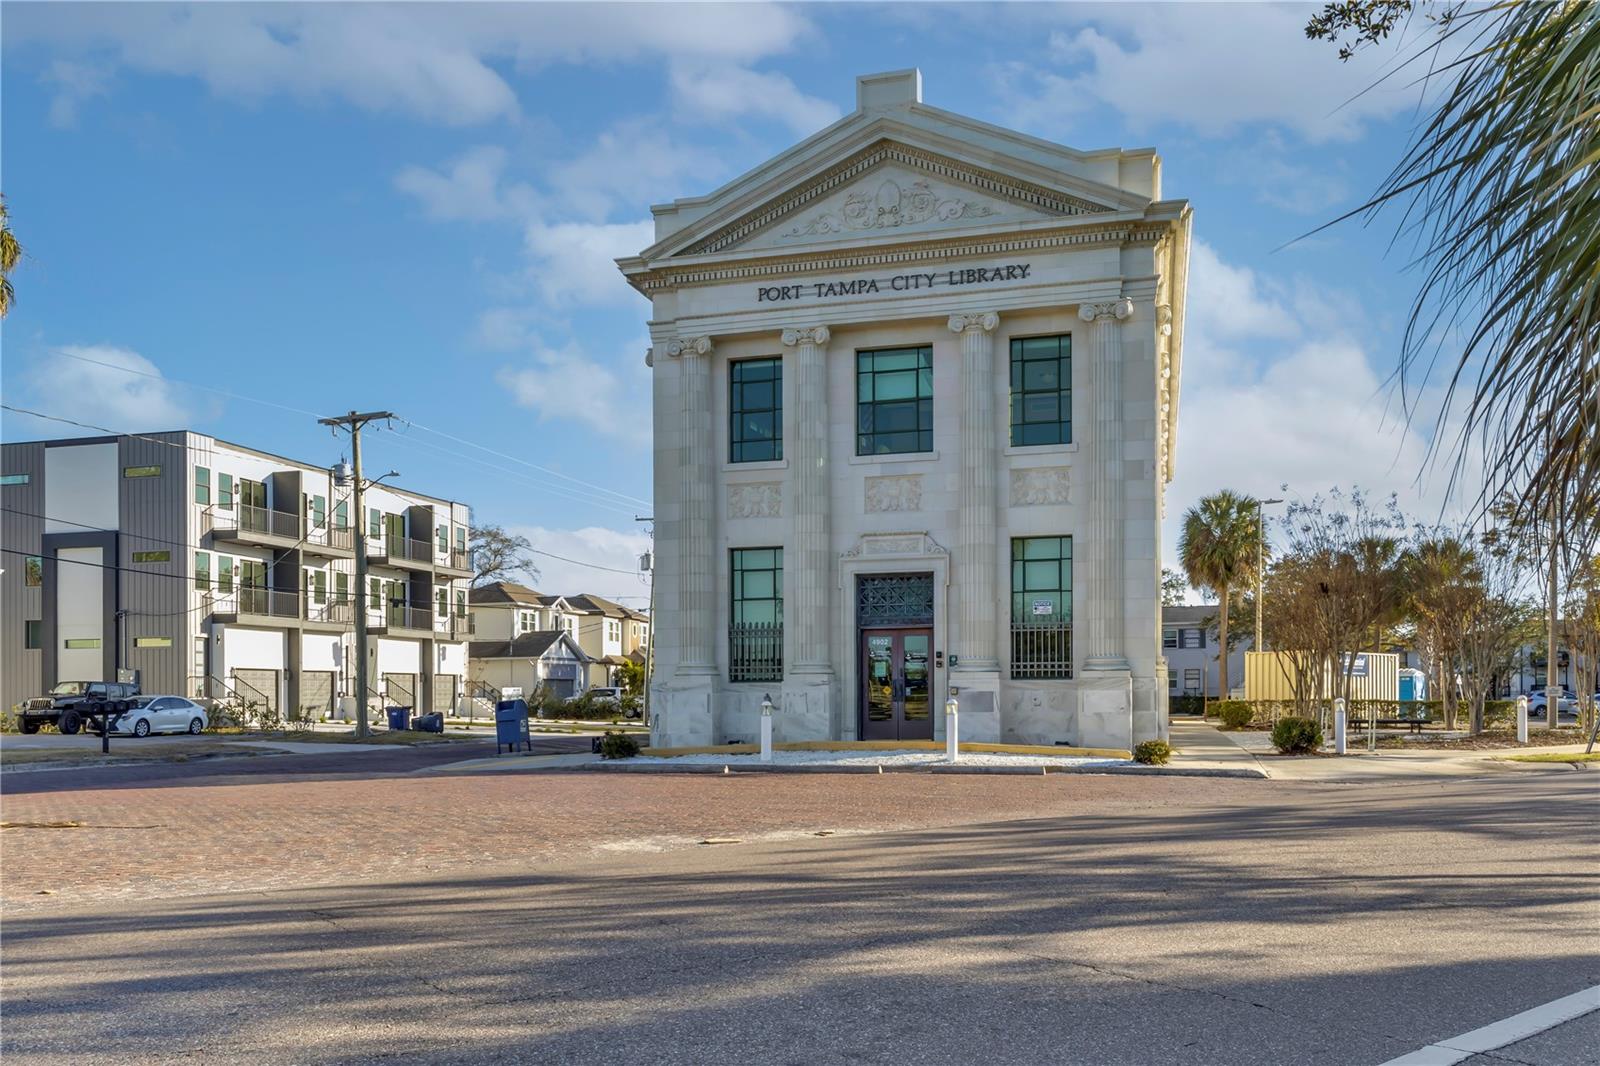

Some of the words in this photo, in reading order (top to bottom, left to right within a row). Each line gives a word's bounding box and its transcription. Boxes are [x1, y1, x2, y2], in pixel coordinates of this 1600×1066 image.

[758, 285, 803, 302] PORT
[815, 279, 880, 298] TAMPA
[891, 272, 937, 291] CITY
[947, 264, 1031, 286] LIBRARY
